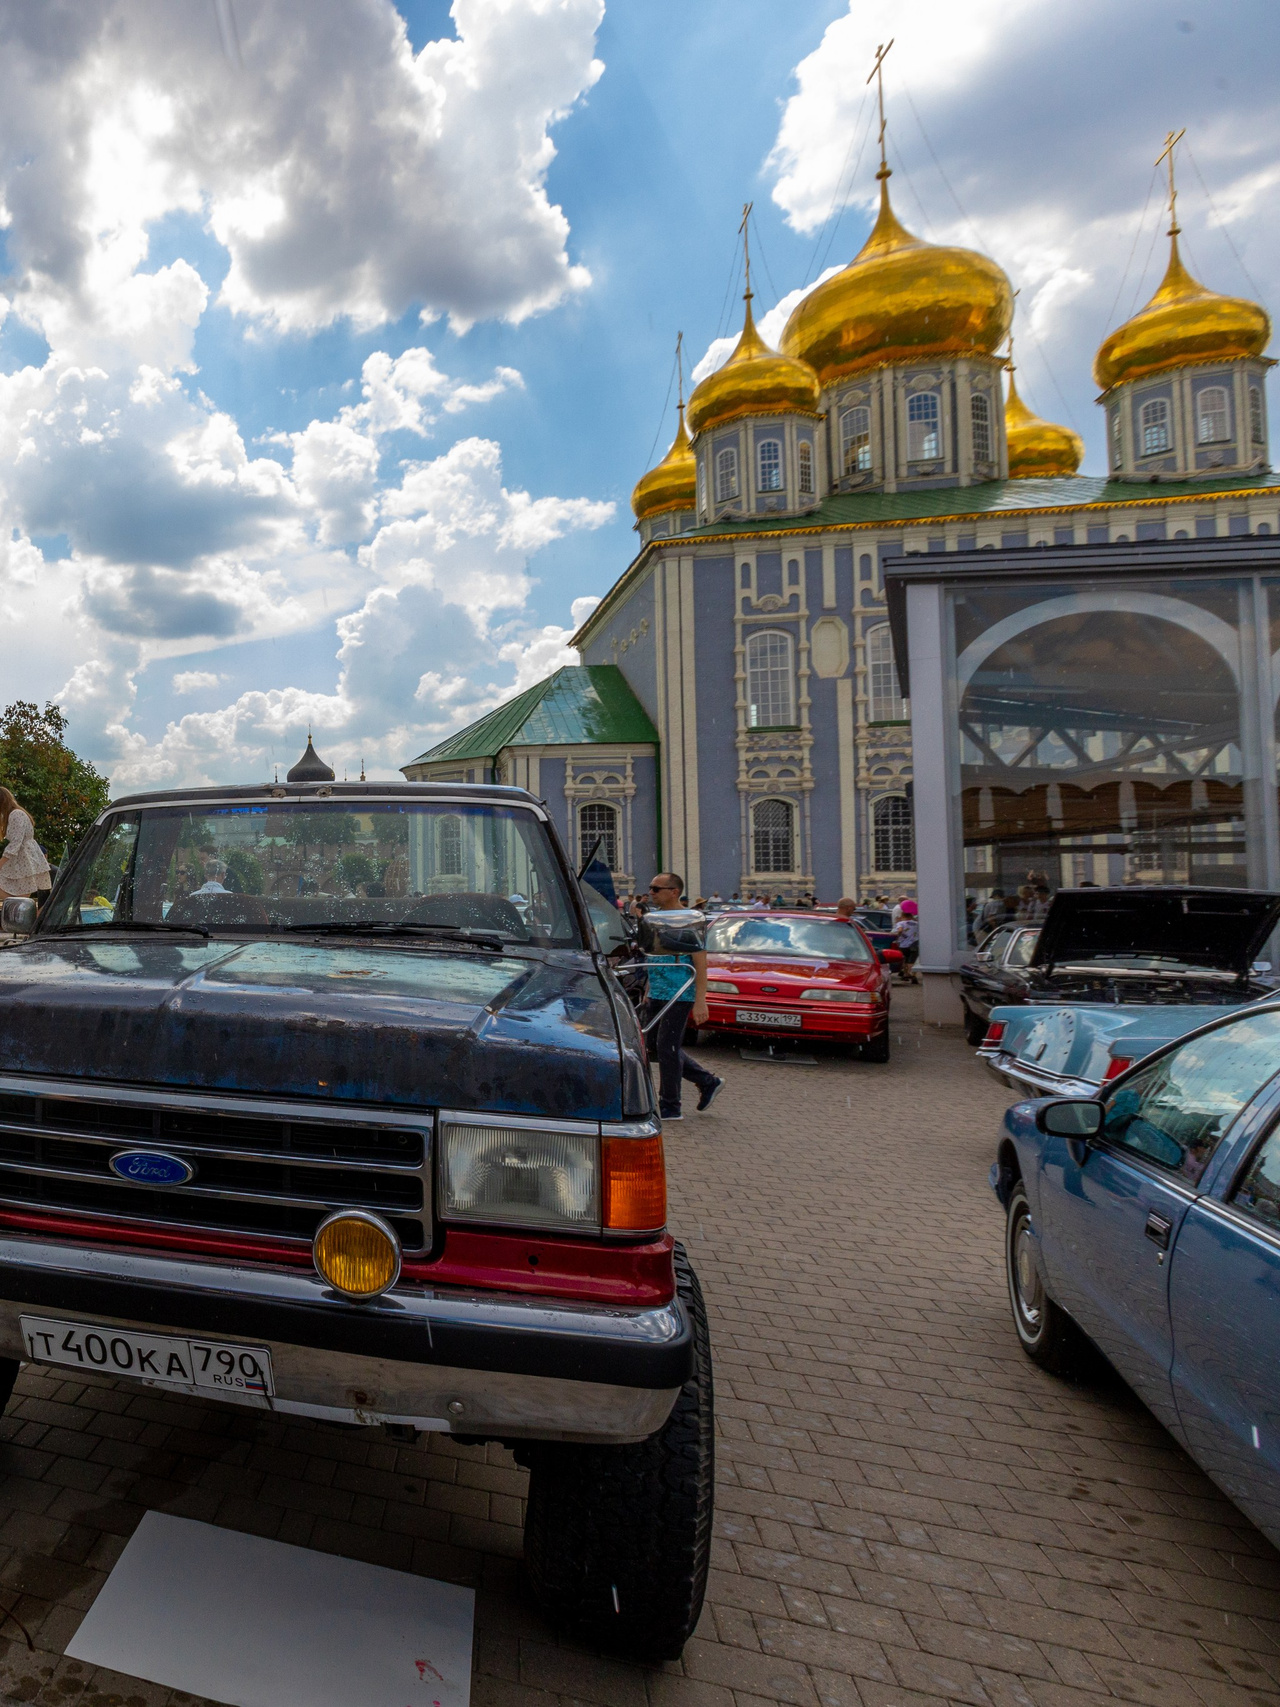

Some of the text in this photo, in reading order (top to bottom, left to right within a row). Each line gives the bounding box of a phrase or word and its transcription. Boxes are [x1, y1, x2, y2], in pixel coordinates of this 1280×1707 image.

[128, 1157, 171, 1178] Ford
[35, 1330, 259, 1379] Т400КА 790
[212, 1374, 244, 1388] RUS
